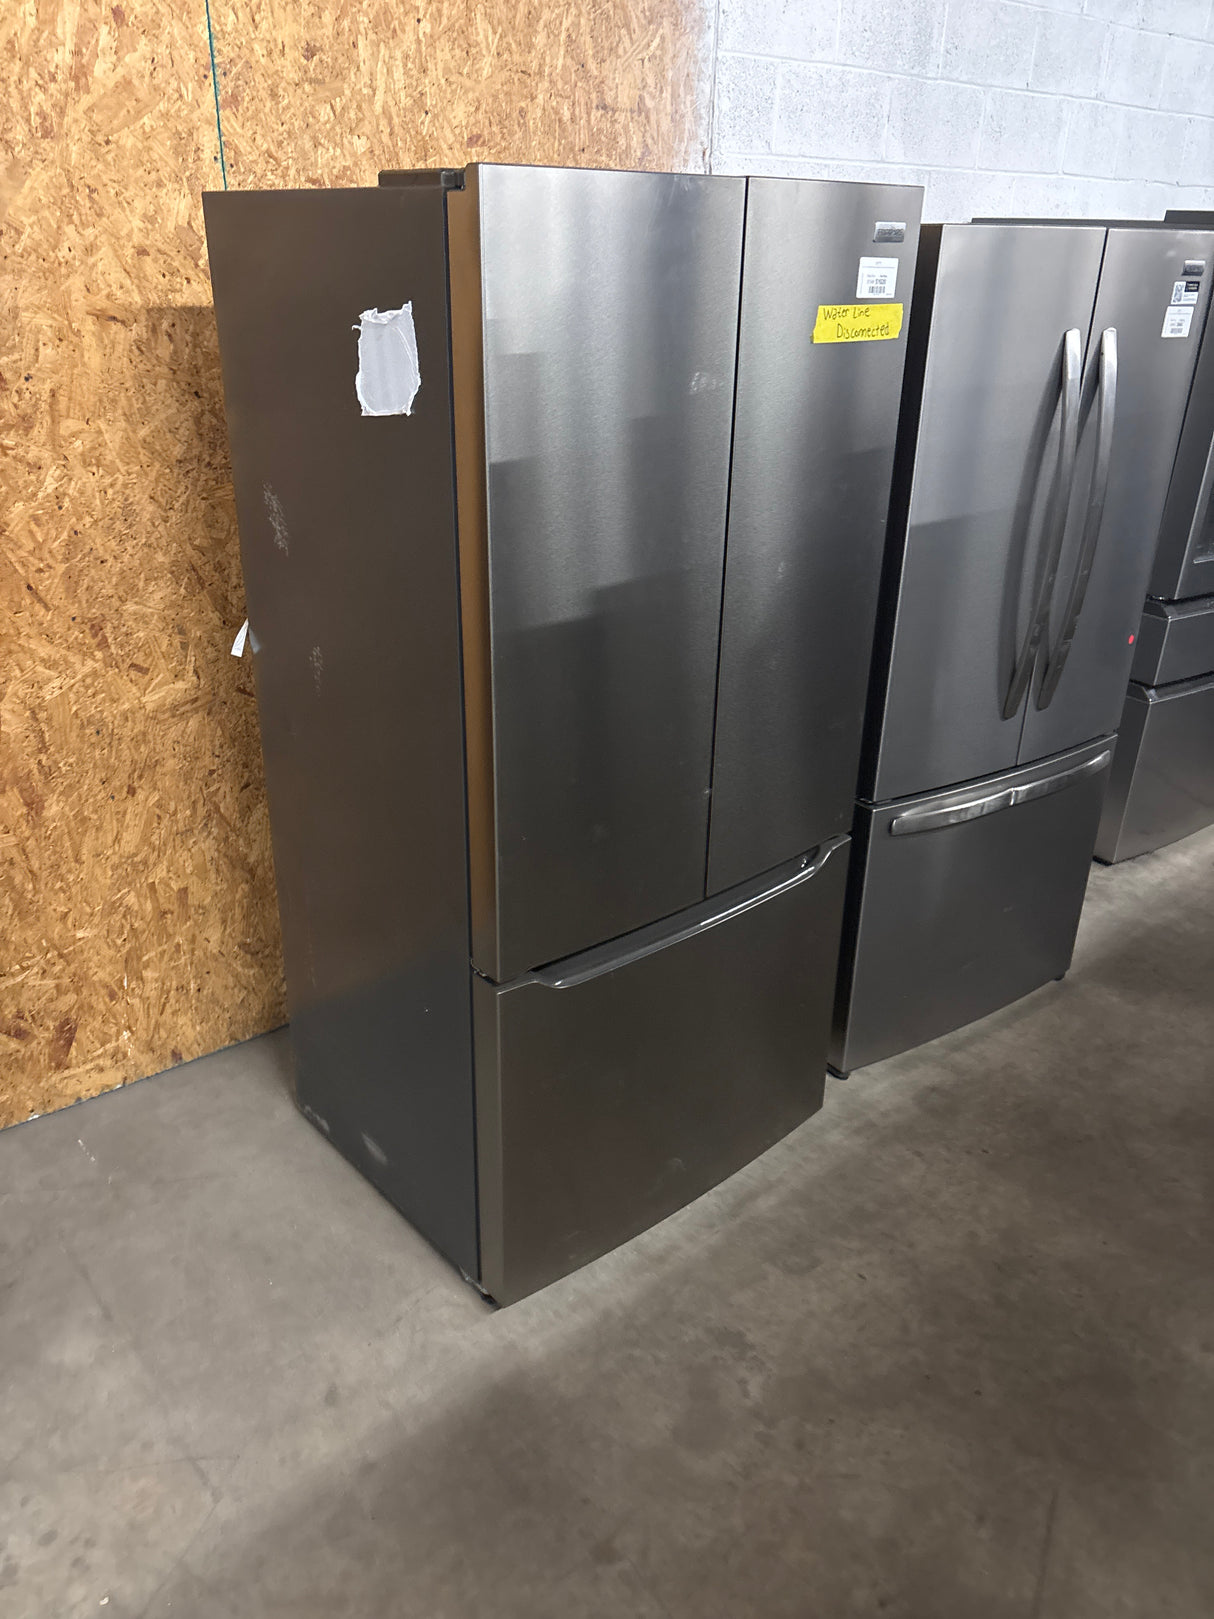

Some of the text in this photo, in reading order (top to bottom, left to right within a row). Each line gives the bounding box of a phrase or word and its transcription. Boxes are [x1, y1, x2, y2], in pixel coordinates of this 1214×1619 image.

[823, 306, 870, 320] Water Line
[836, 322, 890, 339] Disconnected
